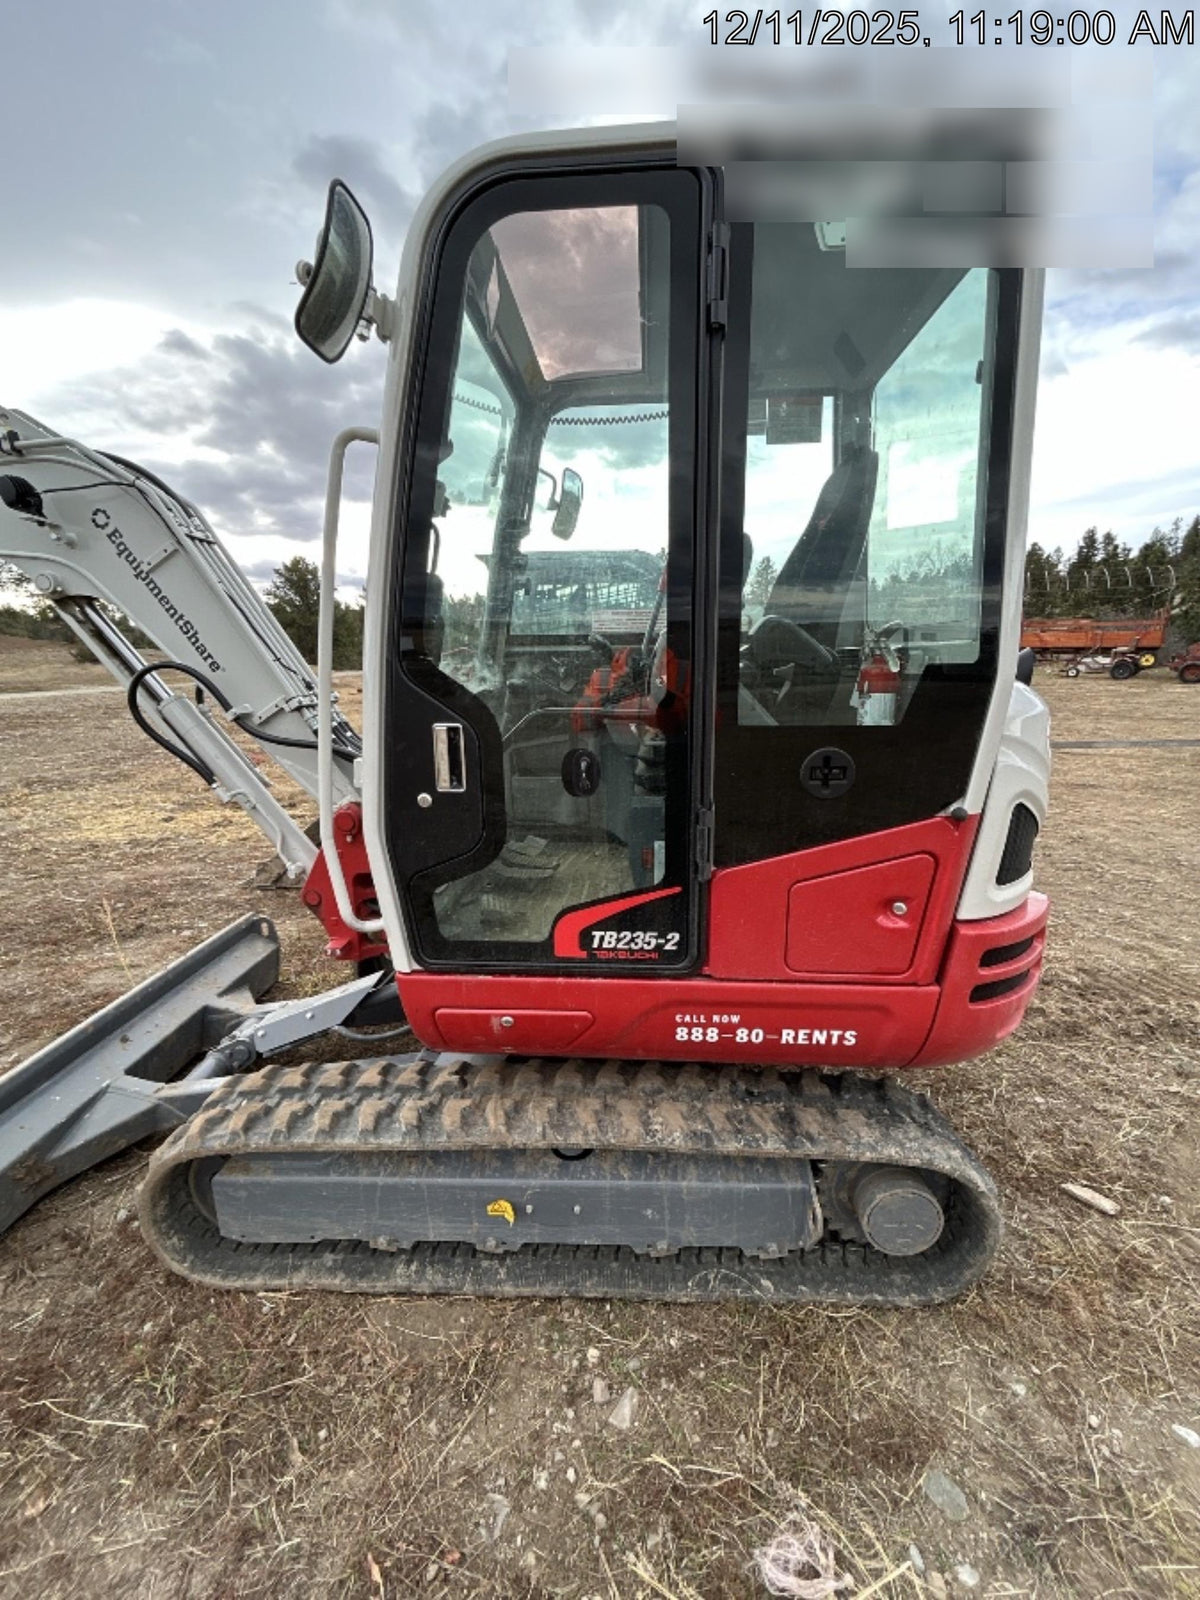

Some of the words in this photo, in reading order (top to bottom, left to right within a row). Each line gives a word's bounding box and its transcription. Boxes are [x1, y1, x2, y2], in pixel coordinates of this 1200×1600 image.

[106, 527, 221, 673] EquipmentShare
[591, 931, 680, 950] TB235-2
[675, 1014, 707, 1023] CALL
[712, 1014, 741, 1024] NOW
[675, 1026, 858, 1046] 888-80-RENTS
